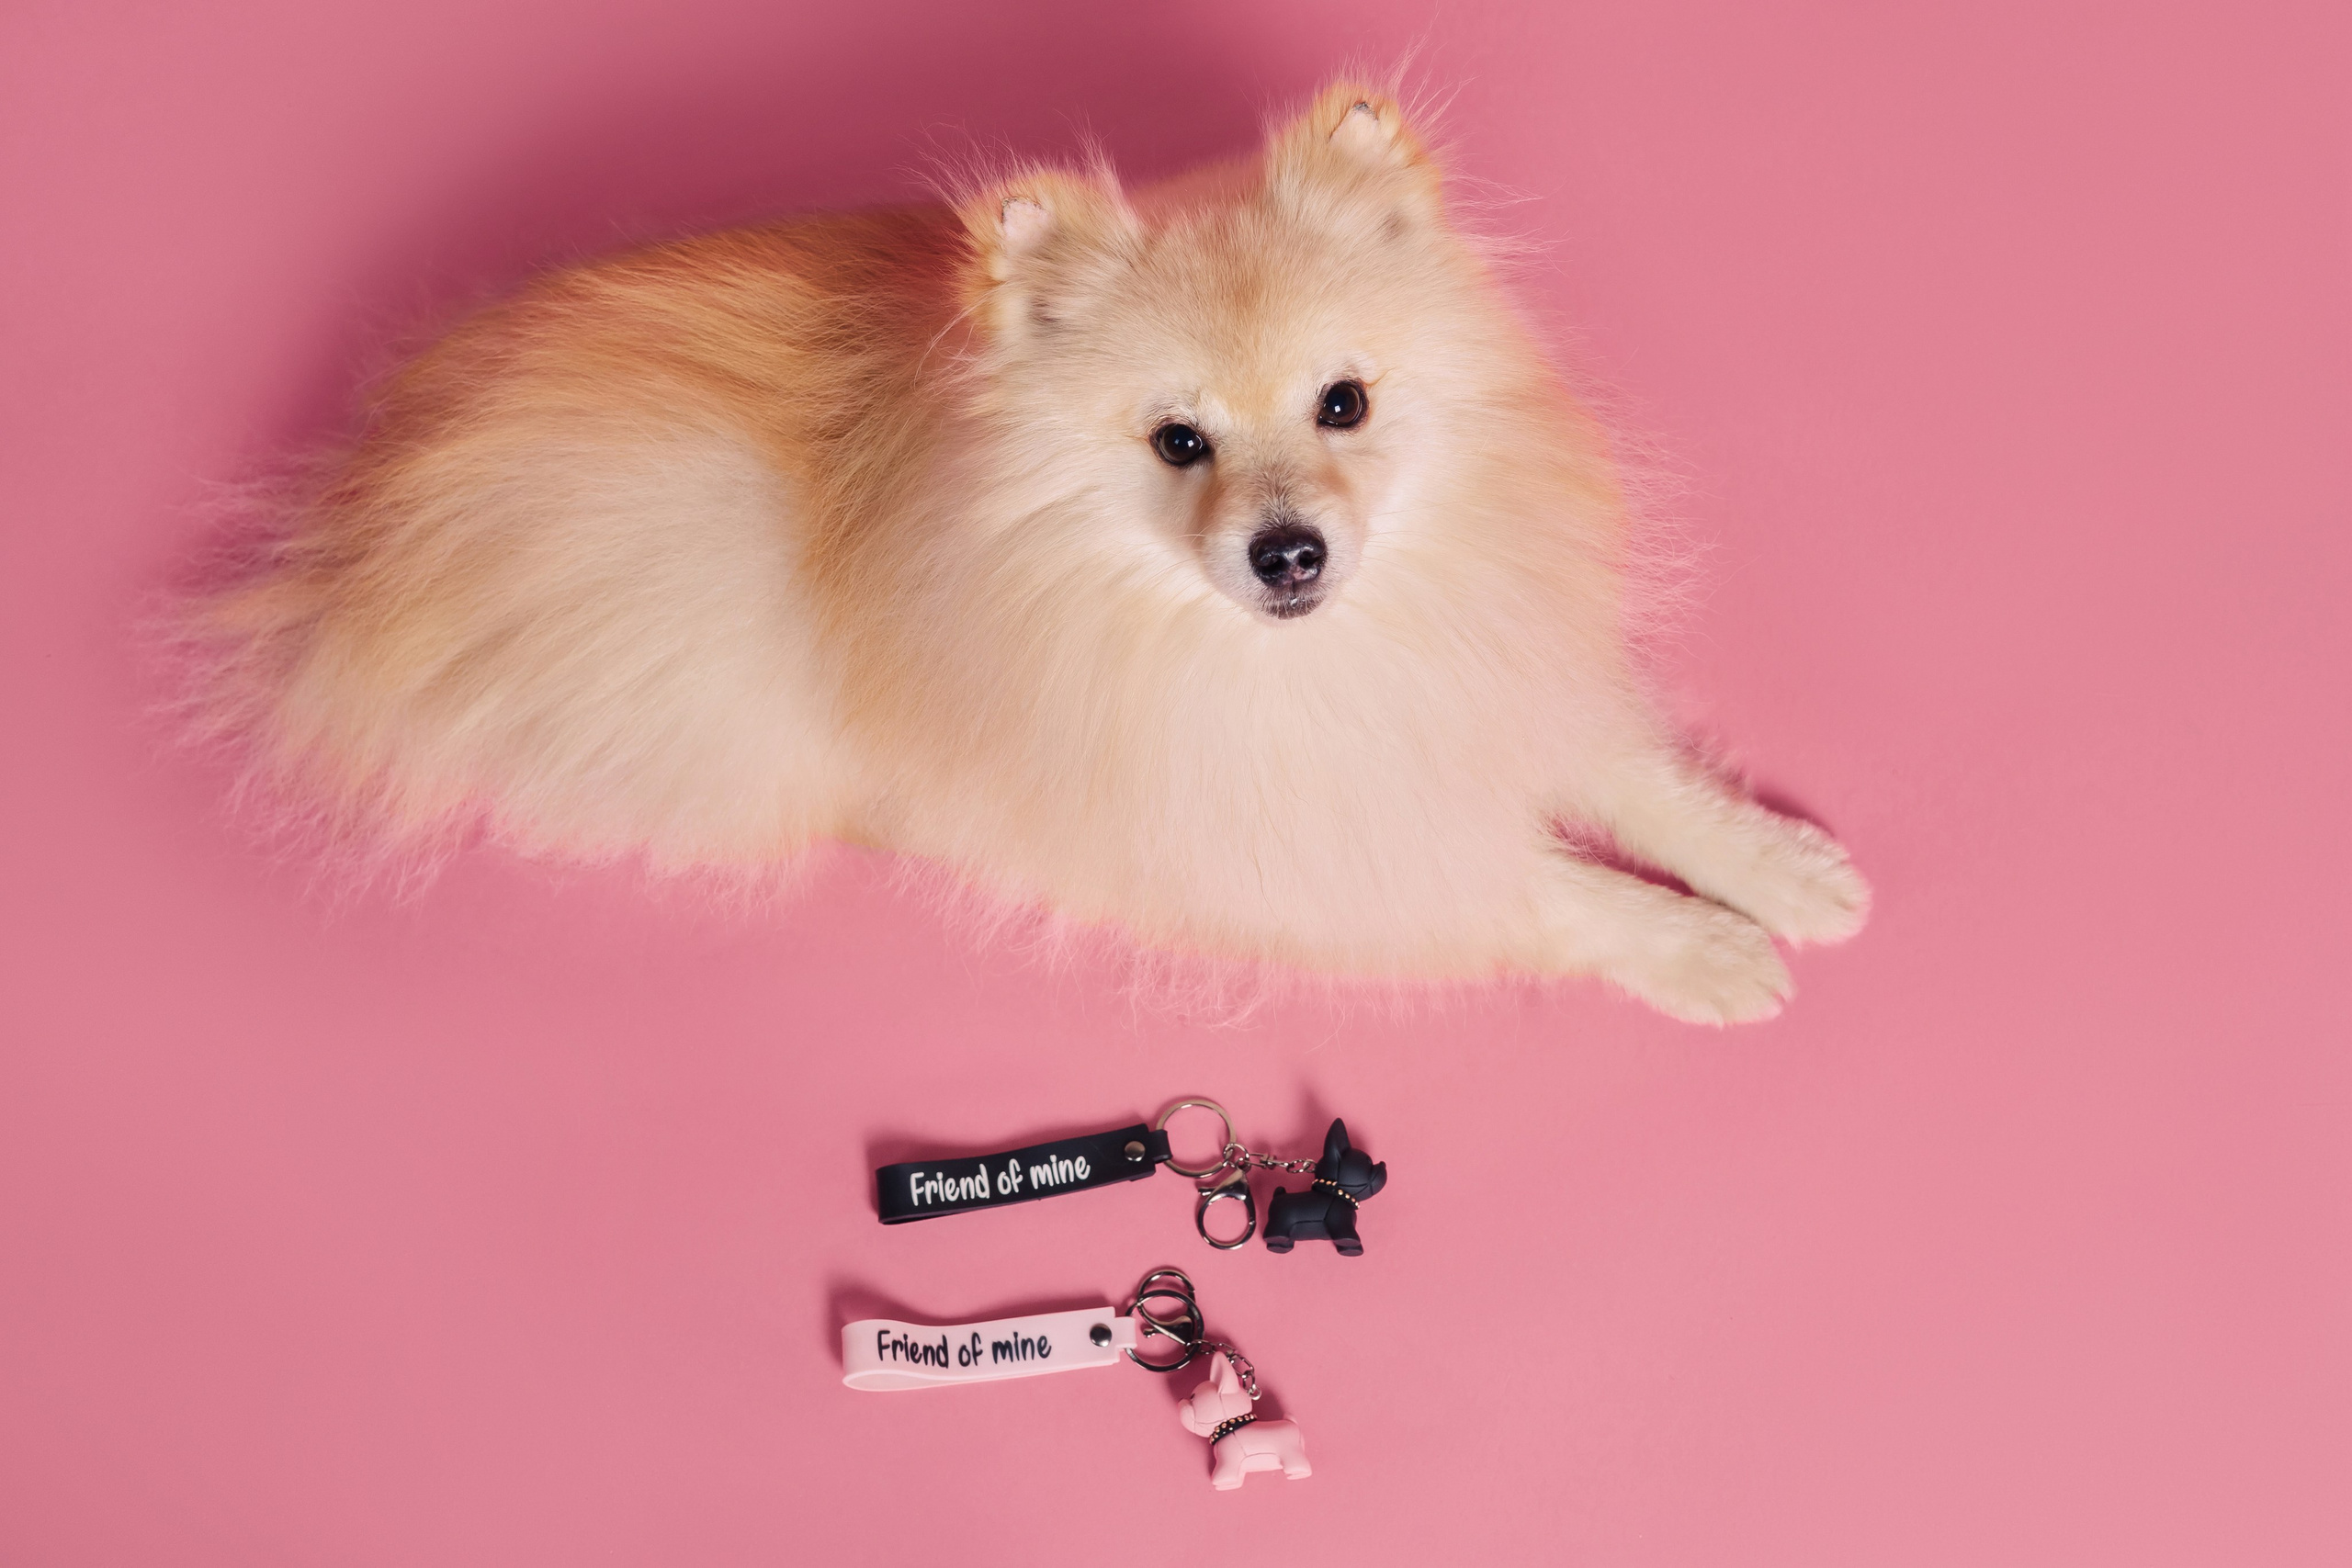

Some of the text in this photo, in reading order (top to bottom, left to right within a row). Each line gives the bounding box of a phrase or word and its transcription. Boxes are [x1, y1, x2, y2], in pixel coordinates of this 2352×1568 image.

[910, 1155, 1091, 1206] Friend of mine
[876, 1330, 1052, 1369] Friend of mine
